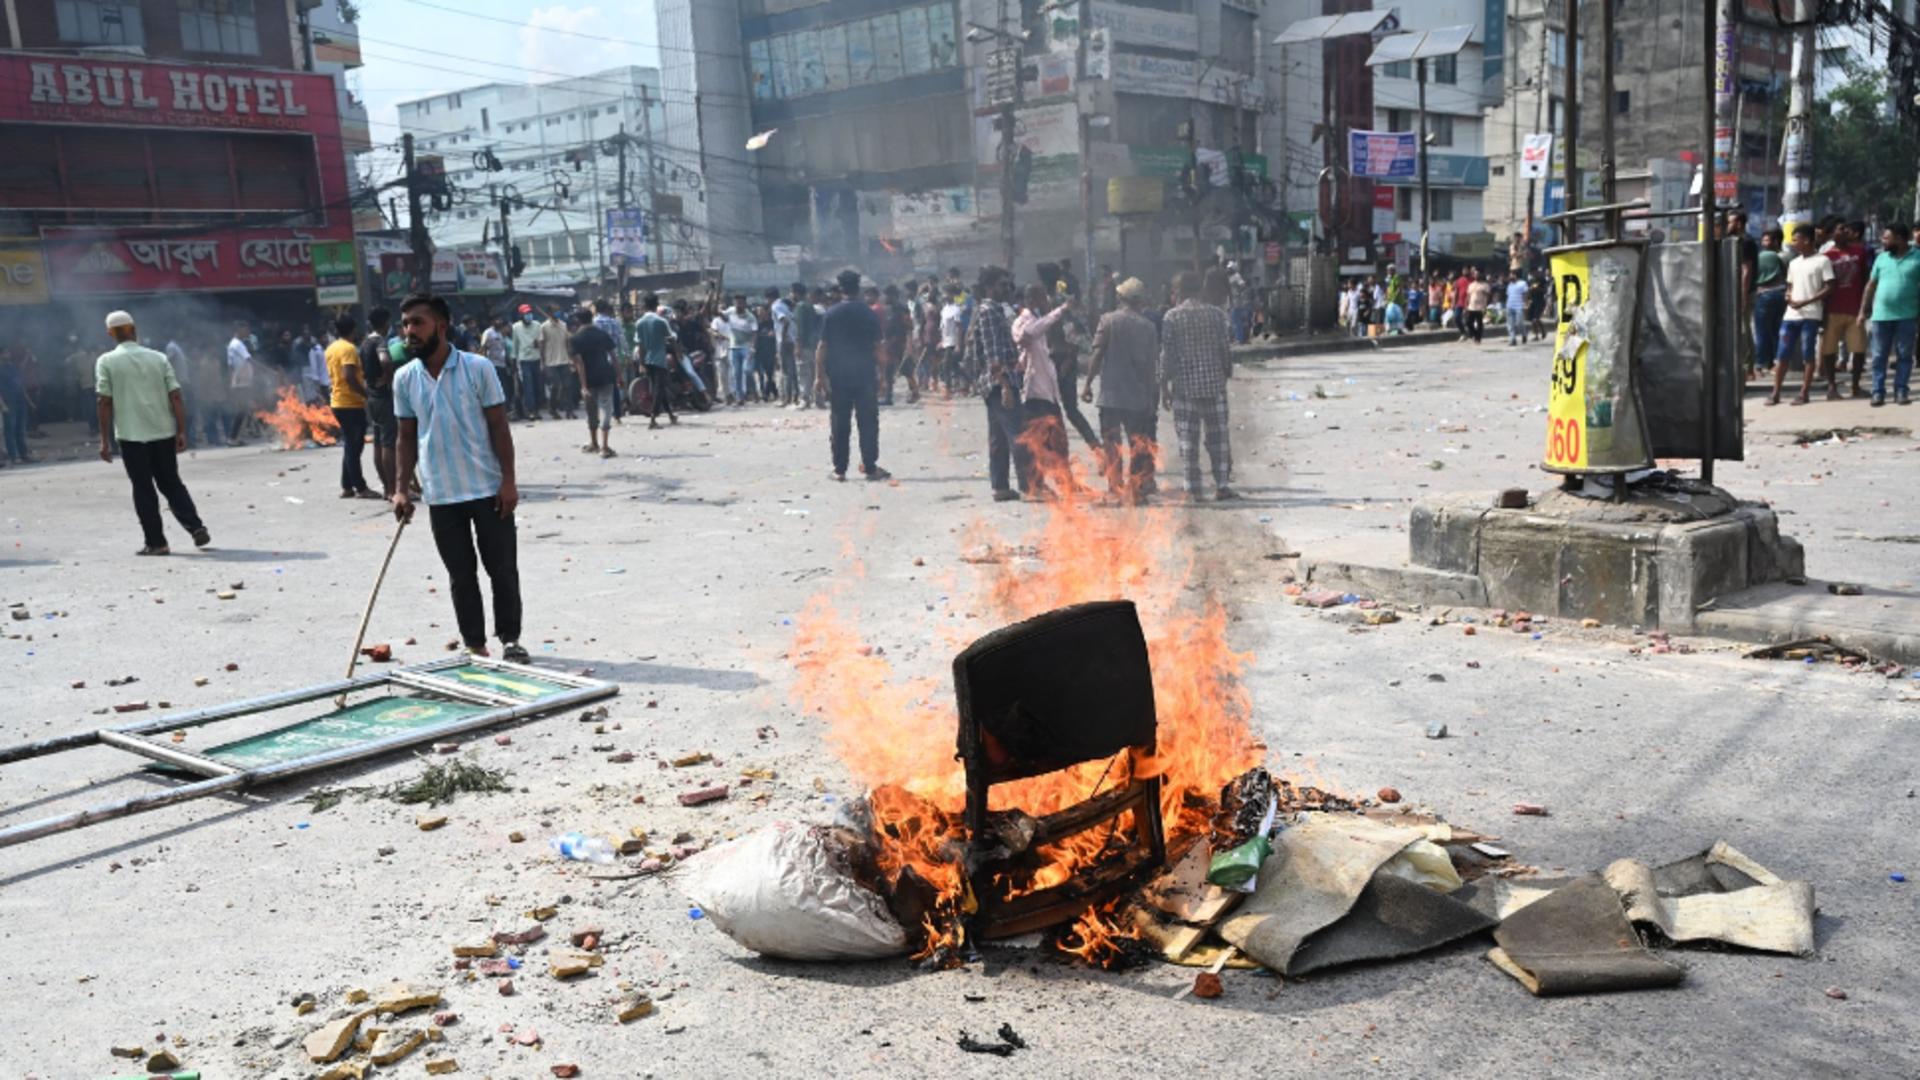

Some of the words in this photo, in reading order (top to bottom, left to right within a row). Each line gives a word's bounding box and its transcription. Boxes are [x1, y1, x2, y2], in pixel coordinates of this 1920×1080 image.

[30, 63, 159, 107] ABUL
[169, 71, 306, 116] HOTEL
[126, 239, 219, 277] আবুল
[240, 231, 312, 268] হোটে
